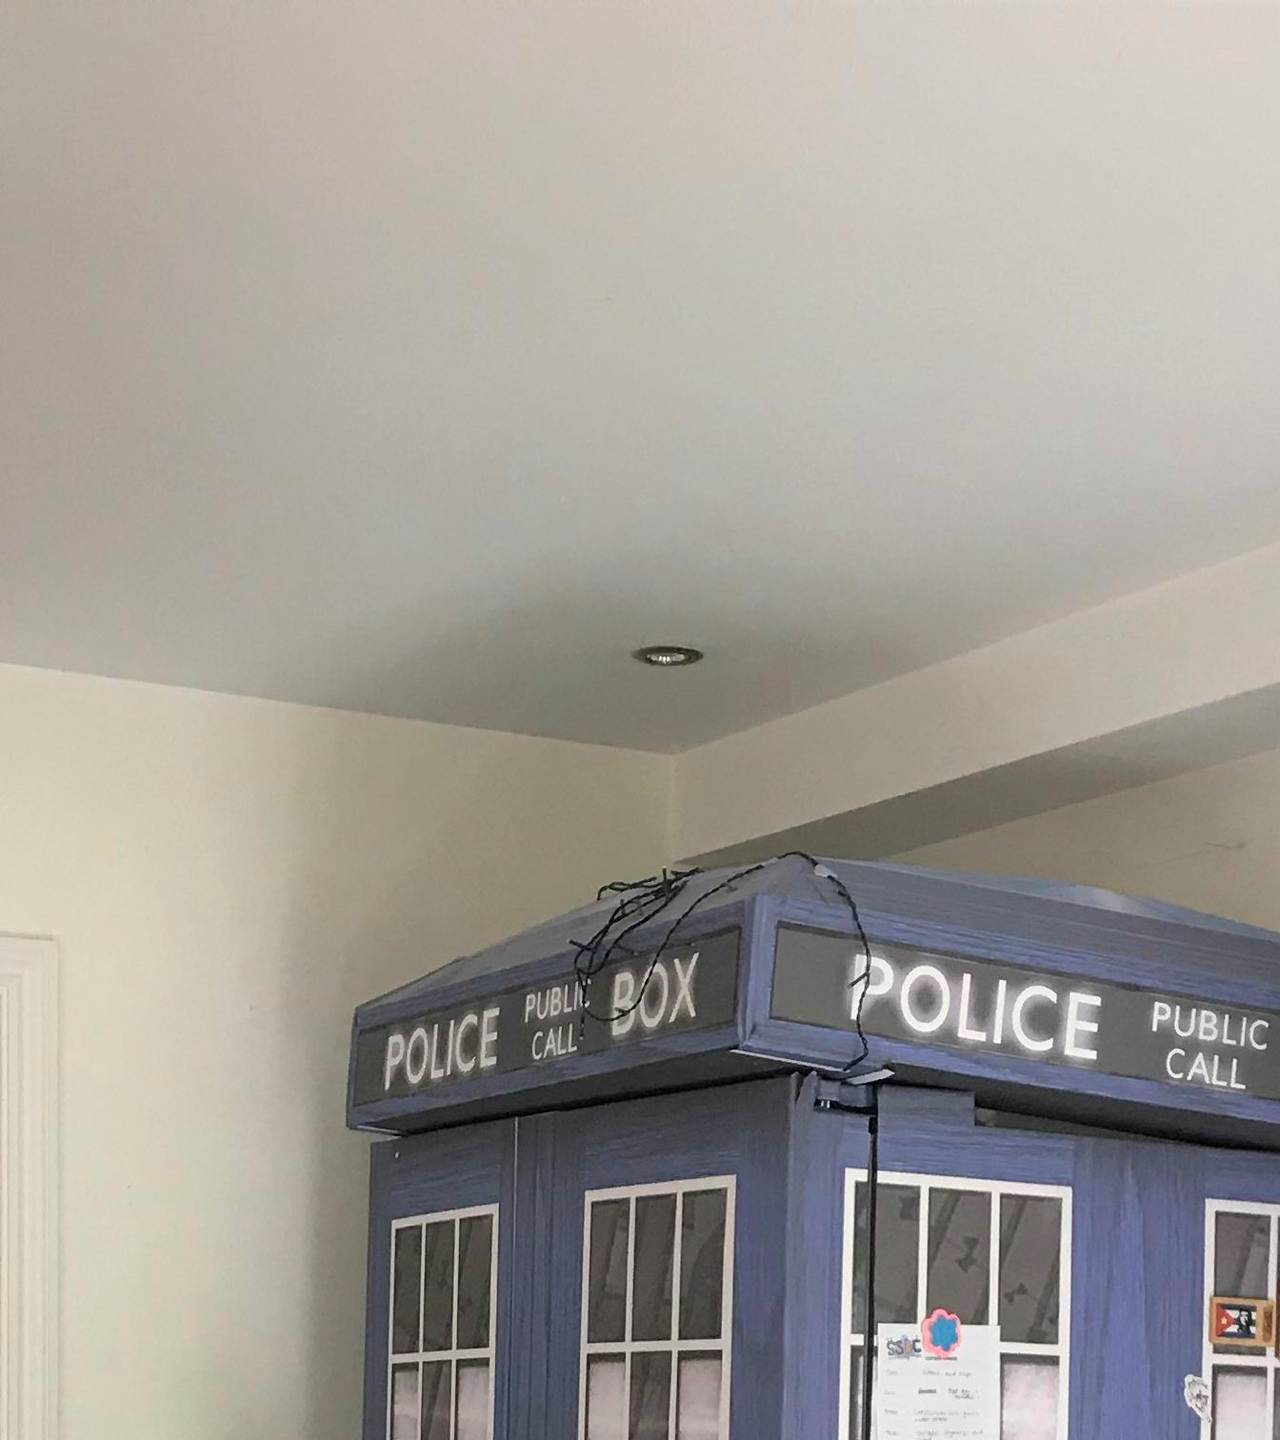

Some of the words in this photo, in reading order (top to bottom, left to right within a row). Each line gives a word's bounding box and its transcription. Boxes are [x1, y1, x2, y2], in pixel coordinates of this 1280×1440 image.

[384, 1007, 500, 1091] POLICE
[611, 952, 699, 1036] BOX
[524, 979, 592, 1023] PUBLIC
[849, 953, 1102, 1060] POLICE
[531, 1023, 578, 1060] CALL
[1152, 1001, 1269, 1050] PUBLIC
[1165, 1047, 1247, 1090] CALL
